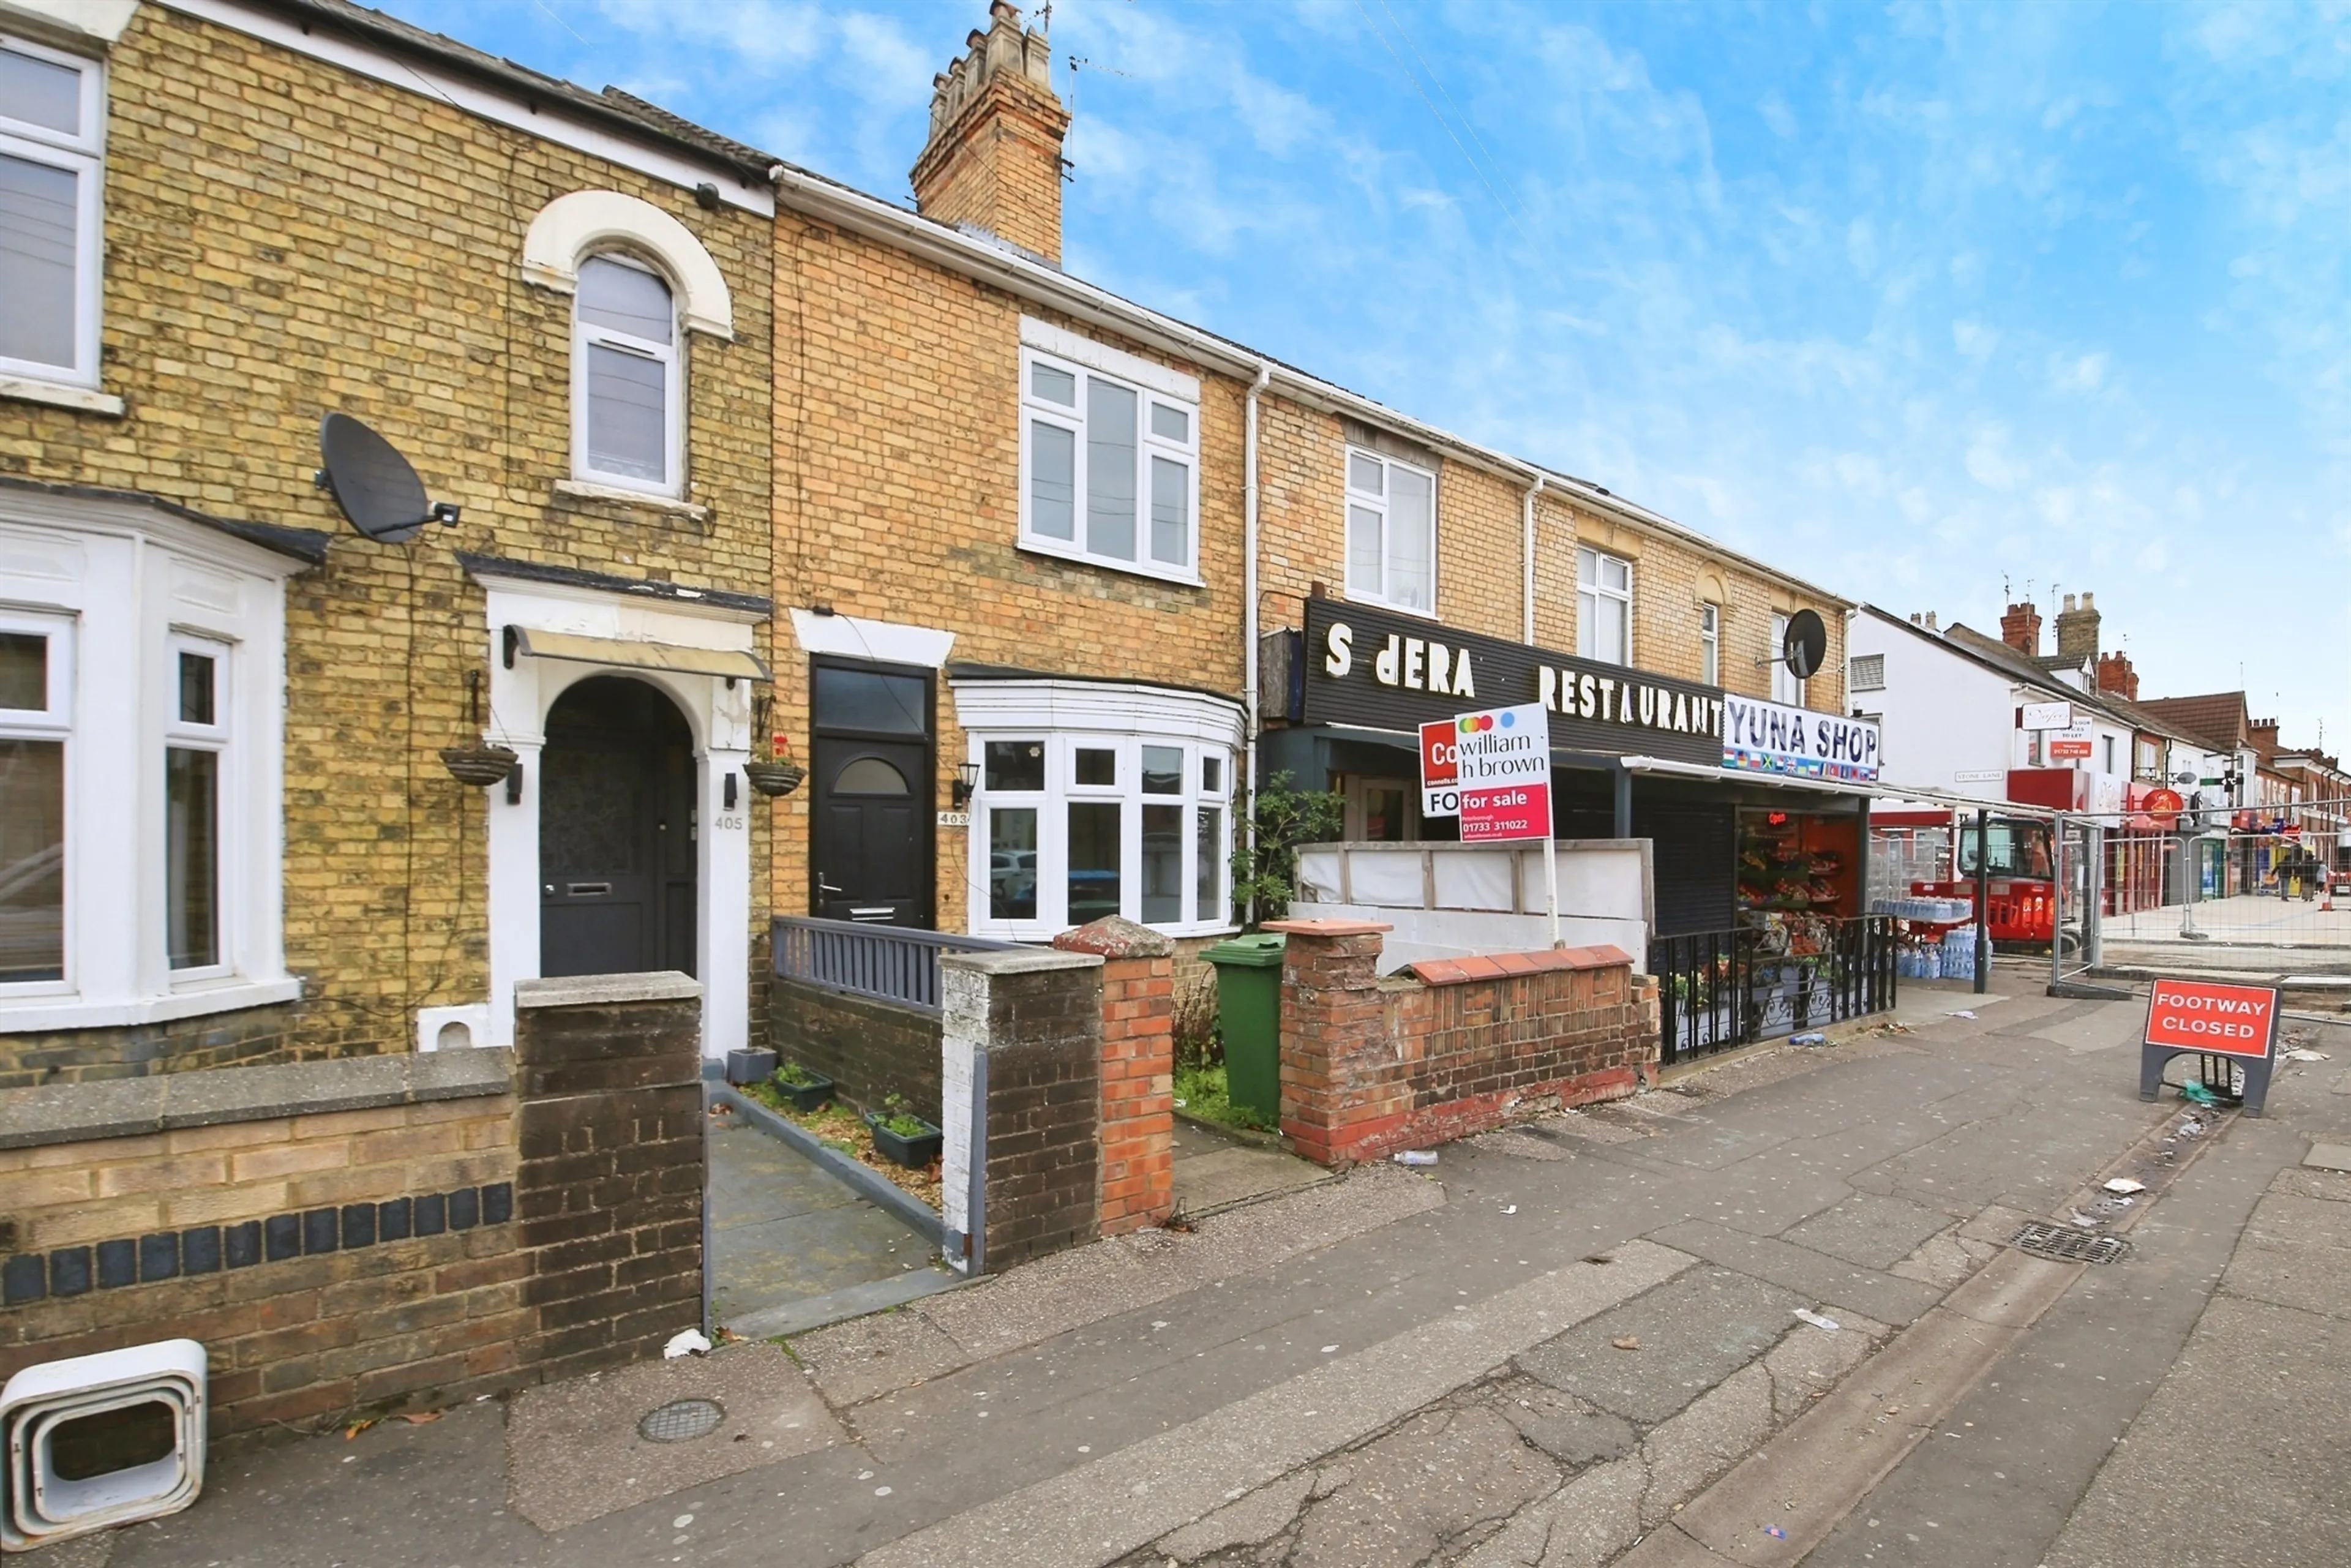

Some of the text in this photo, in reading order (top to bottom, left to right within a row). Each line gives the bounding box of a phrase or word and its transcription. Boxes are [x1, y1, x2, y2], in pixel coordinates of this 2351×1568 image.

[1539, 666, 1722, 737] RESTAURANT
[1728, 701, 1877, 764] YUNA SHOP
[1460, 733, 1531, 756] william
[1463, 756, 1544, 778] h brown
[1462, 790, 1527, 809] for sale
[715, 816, 743, 830] 405
[940, 813, 967, 824] 403
[1463, 820, 1528, 832] 01733 311022
[2158, 993, 2266, 1016] FOOTWAY
[2162, 1016, 2254, 1038] CLOSED
